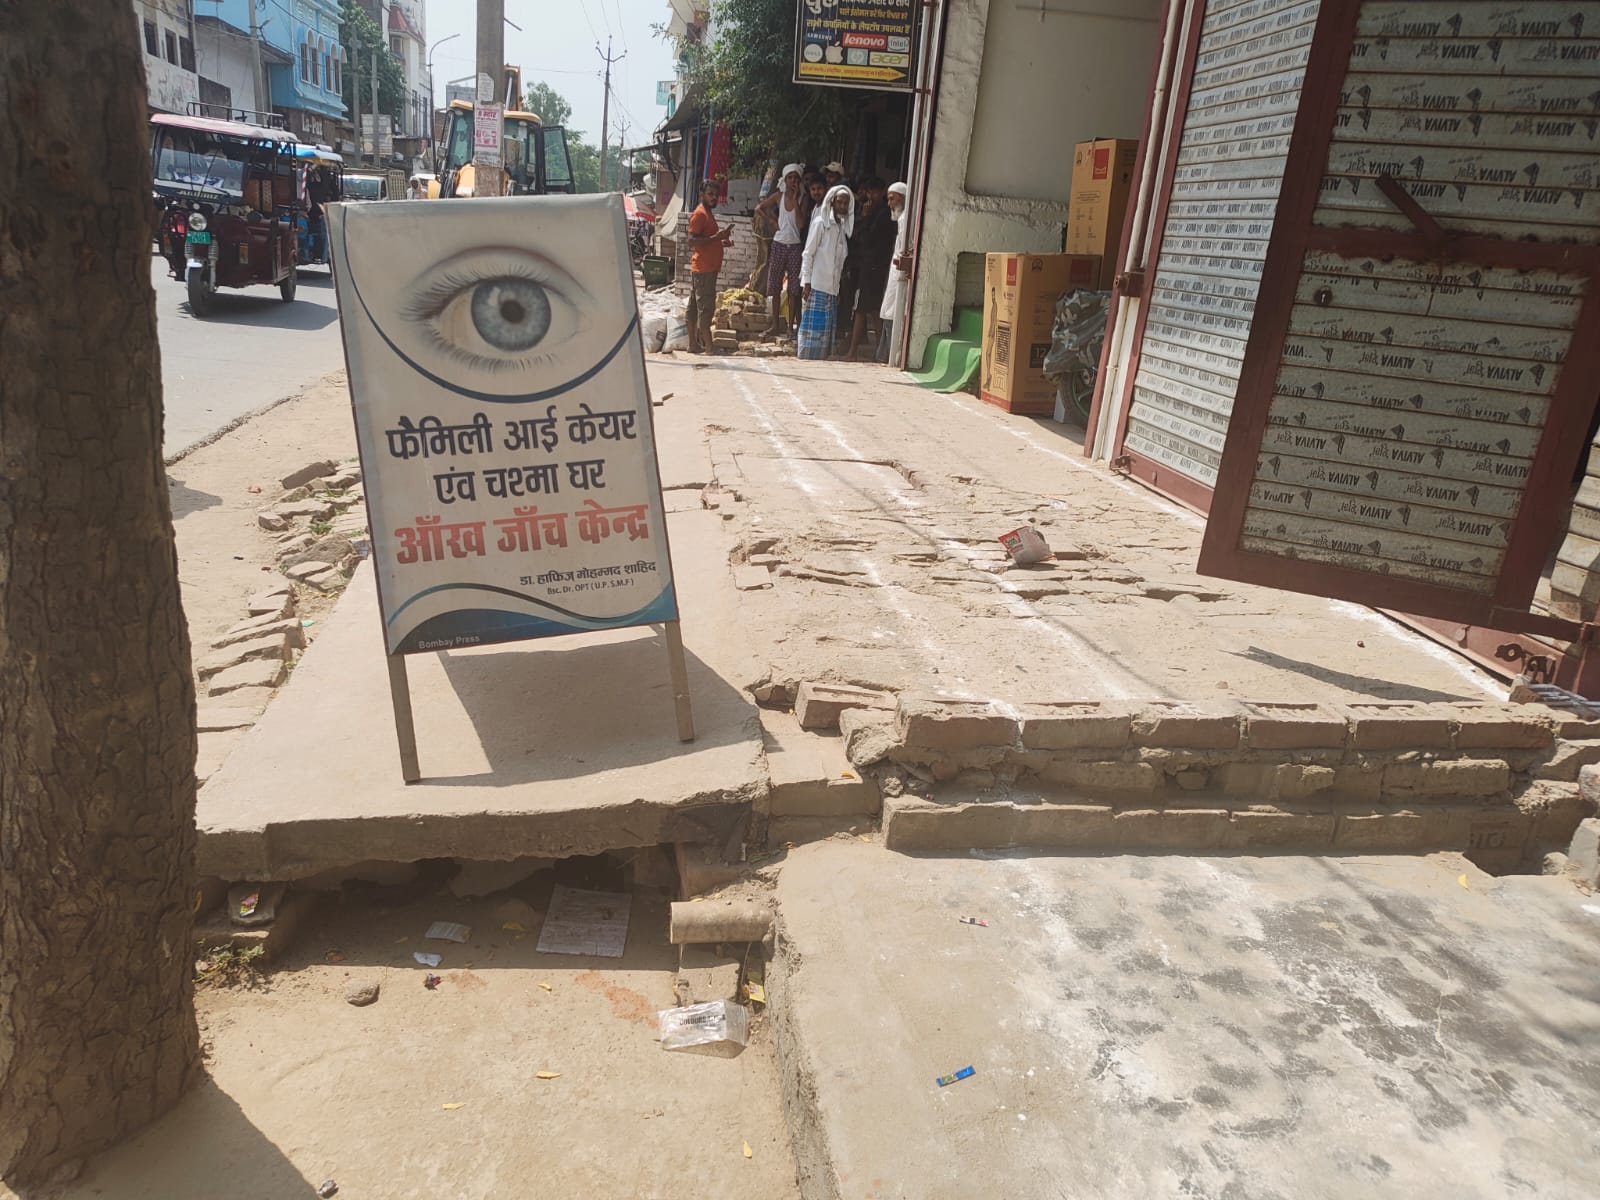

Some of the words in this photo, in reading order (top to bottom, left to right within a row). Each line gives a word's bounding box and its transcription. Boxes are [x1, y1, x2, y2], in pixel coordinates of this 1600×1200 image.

[1520, 21, 1561, 36] ALVIVA
[845, 34, 885, 46] lenovo
[871, 54, 907, 64] acer
[1441, 44, 1480, 60] ALVIVA
[1424, 117, 1461, 132] ALVIVA
[1536, 121, 1576, 136] ALVIVA
[1480, 167, 1517, 183] ALVIVA
[1411, 182, 1446, 198] ALVIVA
[1523, 189, 1562, 205] ALVIVA
[1381, 353, 1416, 369] ALVIVA
[1487, 363, 1524, 381] ALVIVA
[386, 412, 493, 460] फैमिली
[503, 404, 559, 453] आई
[565, 402, 638, 445] केयर
[1295, 435, 1327, 450] ALVIVA
[1391, 448, 1426, 465] ALVIVA
[483, 461, 559, 499] चश्मा
[567, 458, 606, 490] घर
[1328, 470, 1361, 487] ALVIVA
[1495, 462, 1530, 479] ALVIVA
[1426, 486, 1460, 503] ALVIVA
[1359, 503, 1392, 521] ALVIVA
[394, 514, 486, 565] आँख
[493, 505, 568, 553] जाँच
[574, 499, 650, 546] केन्द्र
[1458, 519, 1493, 537] ALVIVA
[519, 575, 535, 586] डा.
[576, 567, 622, 580] मोहम्मद
[624, 561, 657, 575] शाहिद
[575, 583, 590, 592] OPT
[418, 637, 455, 650] Bombay
[456, 633, 481, 647] Press
